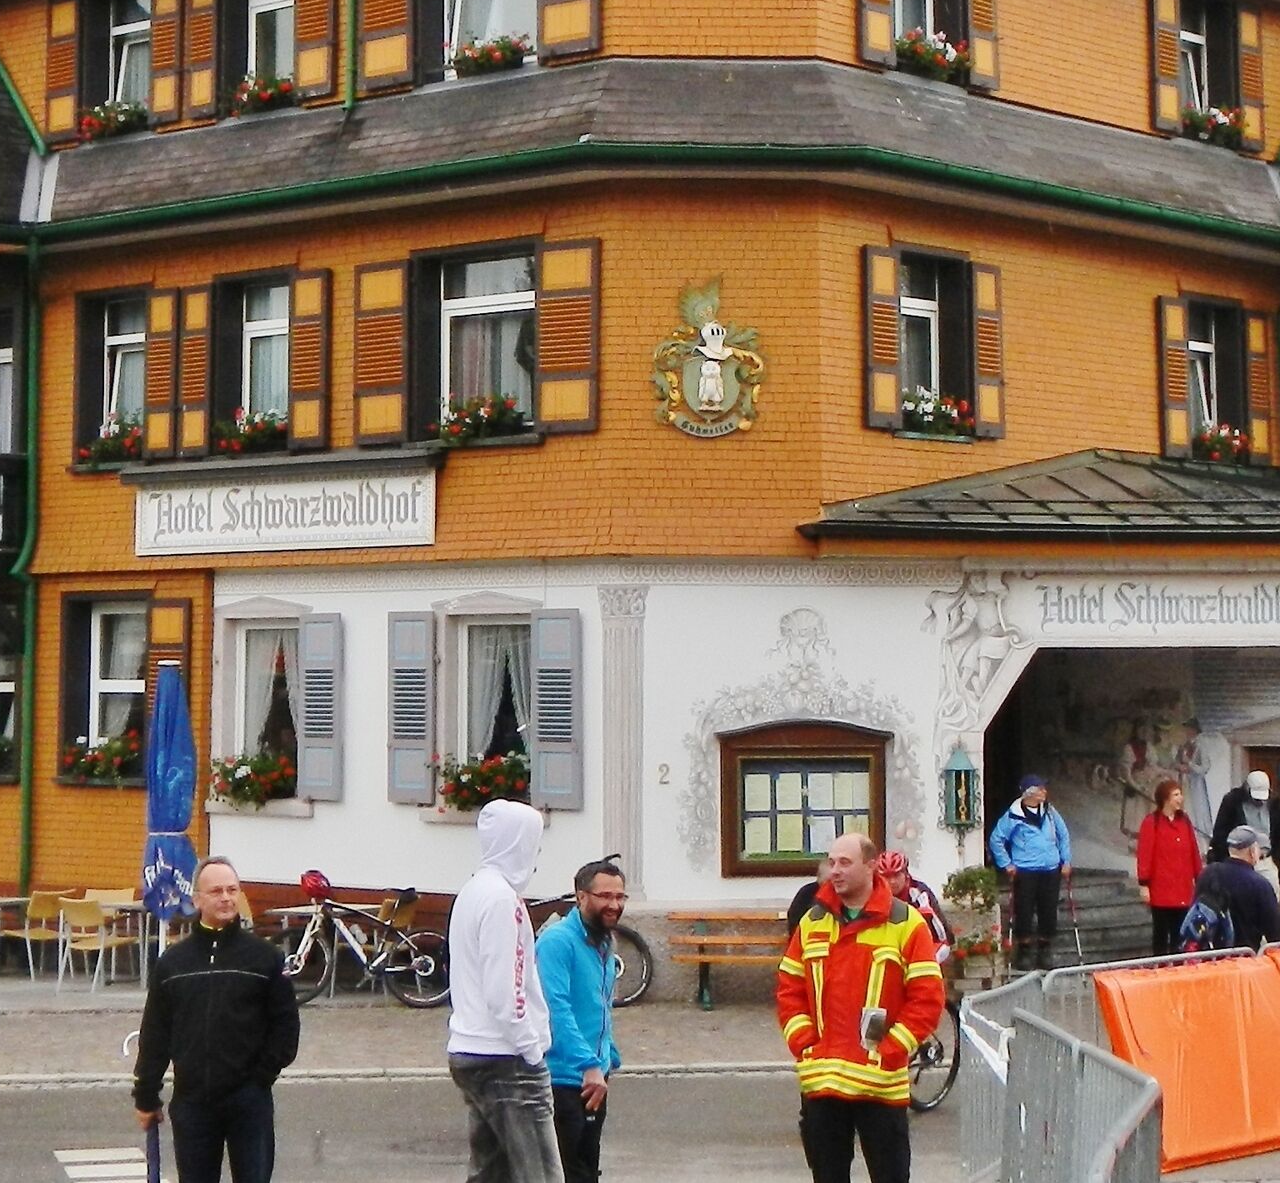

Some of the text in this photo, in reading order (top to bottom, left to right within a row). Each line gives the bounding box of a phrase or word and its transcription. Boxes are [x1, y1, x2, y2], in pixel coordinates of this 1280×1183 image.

[148, 478, 424, 544] Hotel Schwarzwaldhof
[1035, 582, 1107, 634] Hotel
[658, 762, 670, 785] 2
